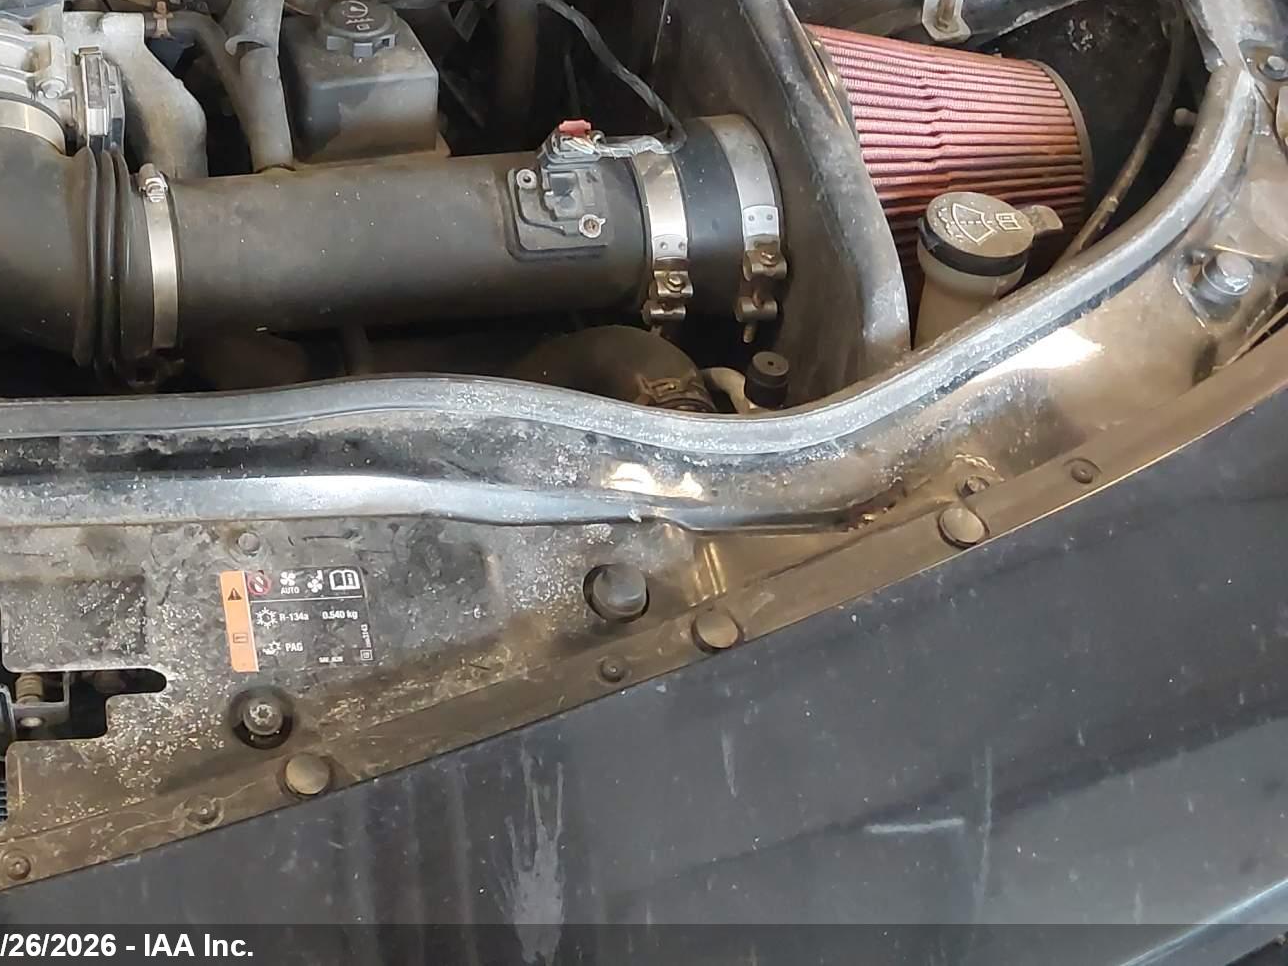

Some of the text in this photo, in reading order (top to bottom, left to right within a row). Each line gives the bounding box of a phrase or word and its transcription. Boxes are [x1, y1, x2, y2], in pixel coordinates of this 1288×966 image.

[280, 586, 300, 595] AUTO
[279, 612, 309, 622] R-134a
[346, 609, 359, 621] kg
[285, 641, 304, 652] PAG
